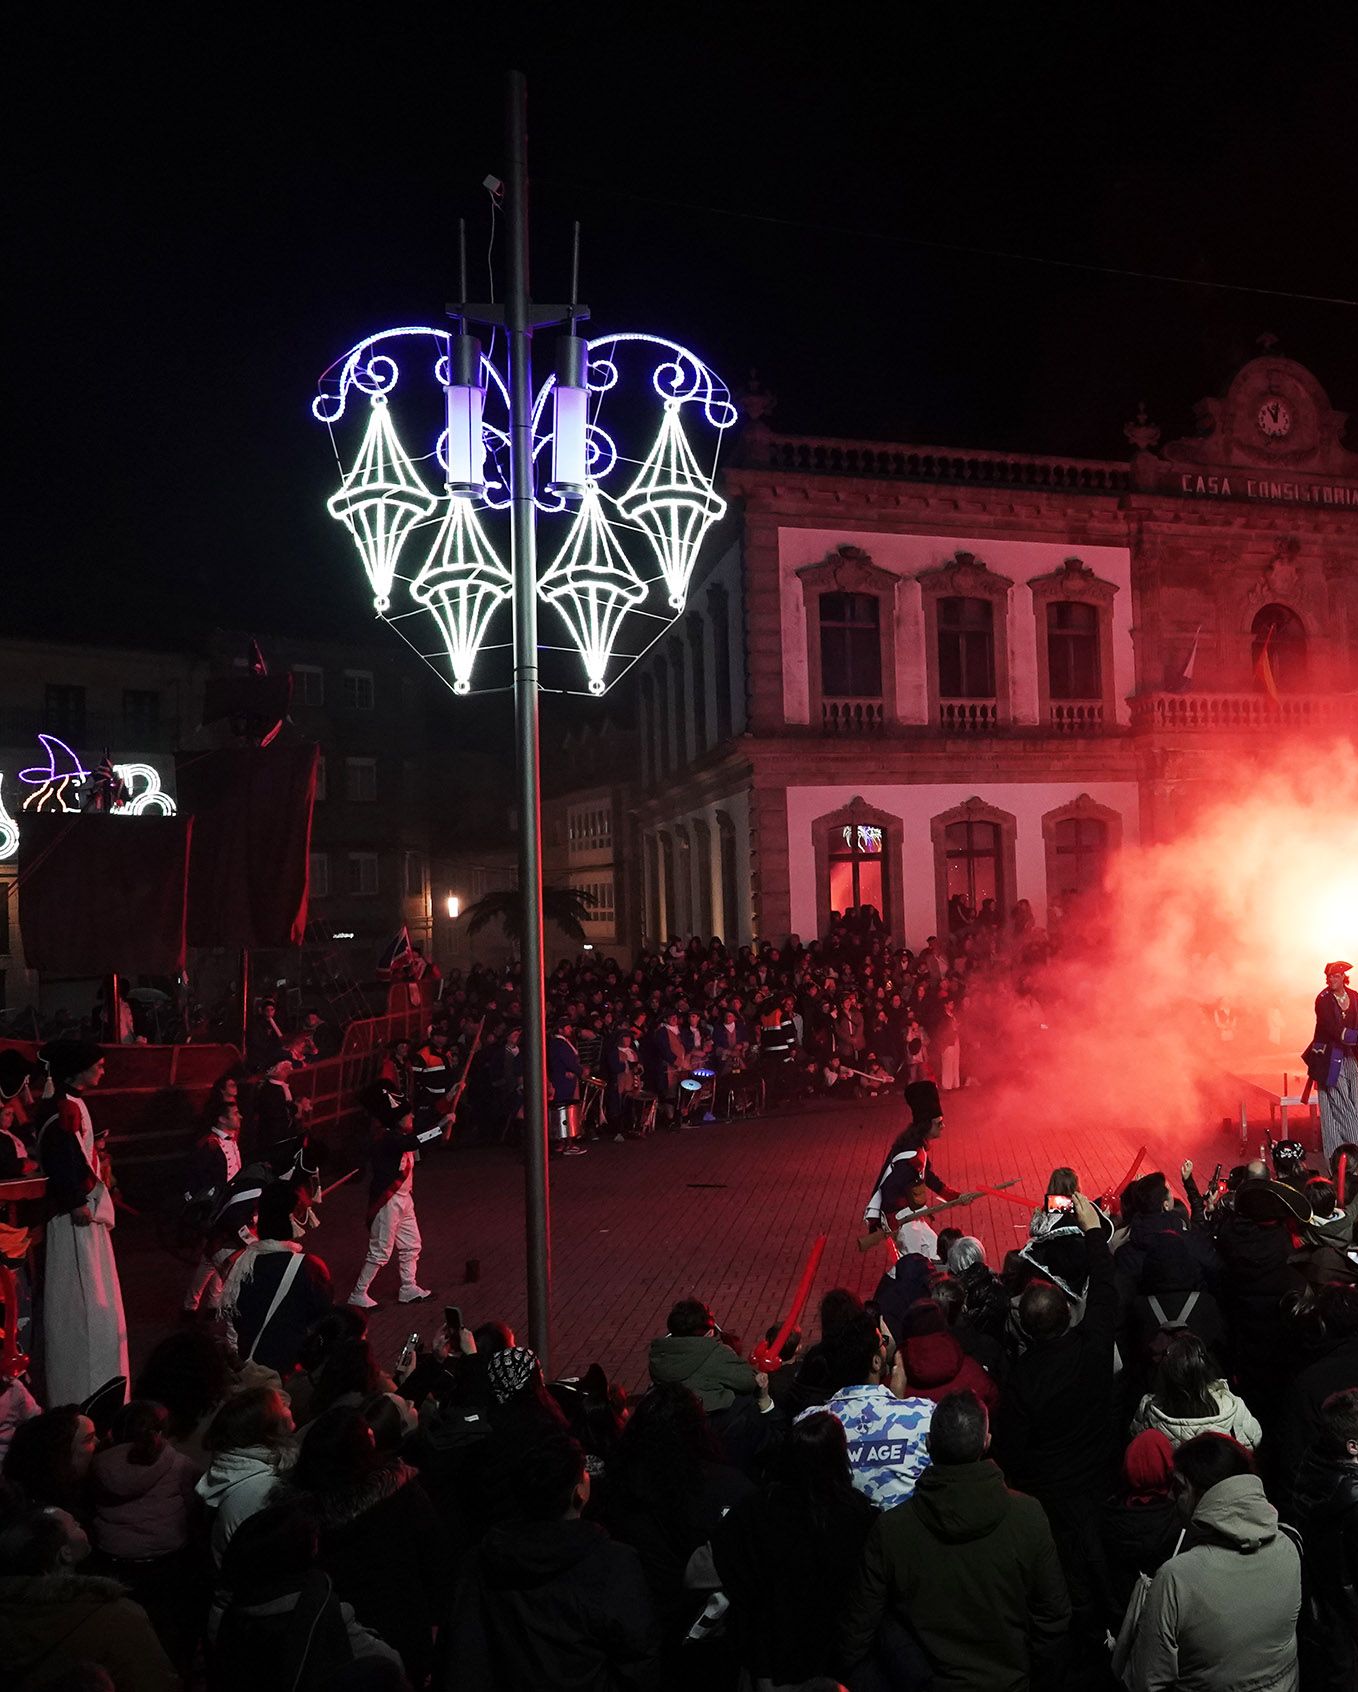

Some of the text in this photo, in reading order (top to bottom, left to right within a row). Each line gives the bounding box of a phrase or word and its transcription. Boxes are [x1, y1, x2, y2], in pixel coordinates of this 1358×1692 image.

[1181, 474, 1232, 495] CASA
[846, 1444, 903, 1462] W AGE
